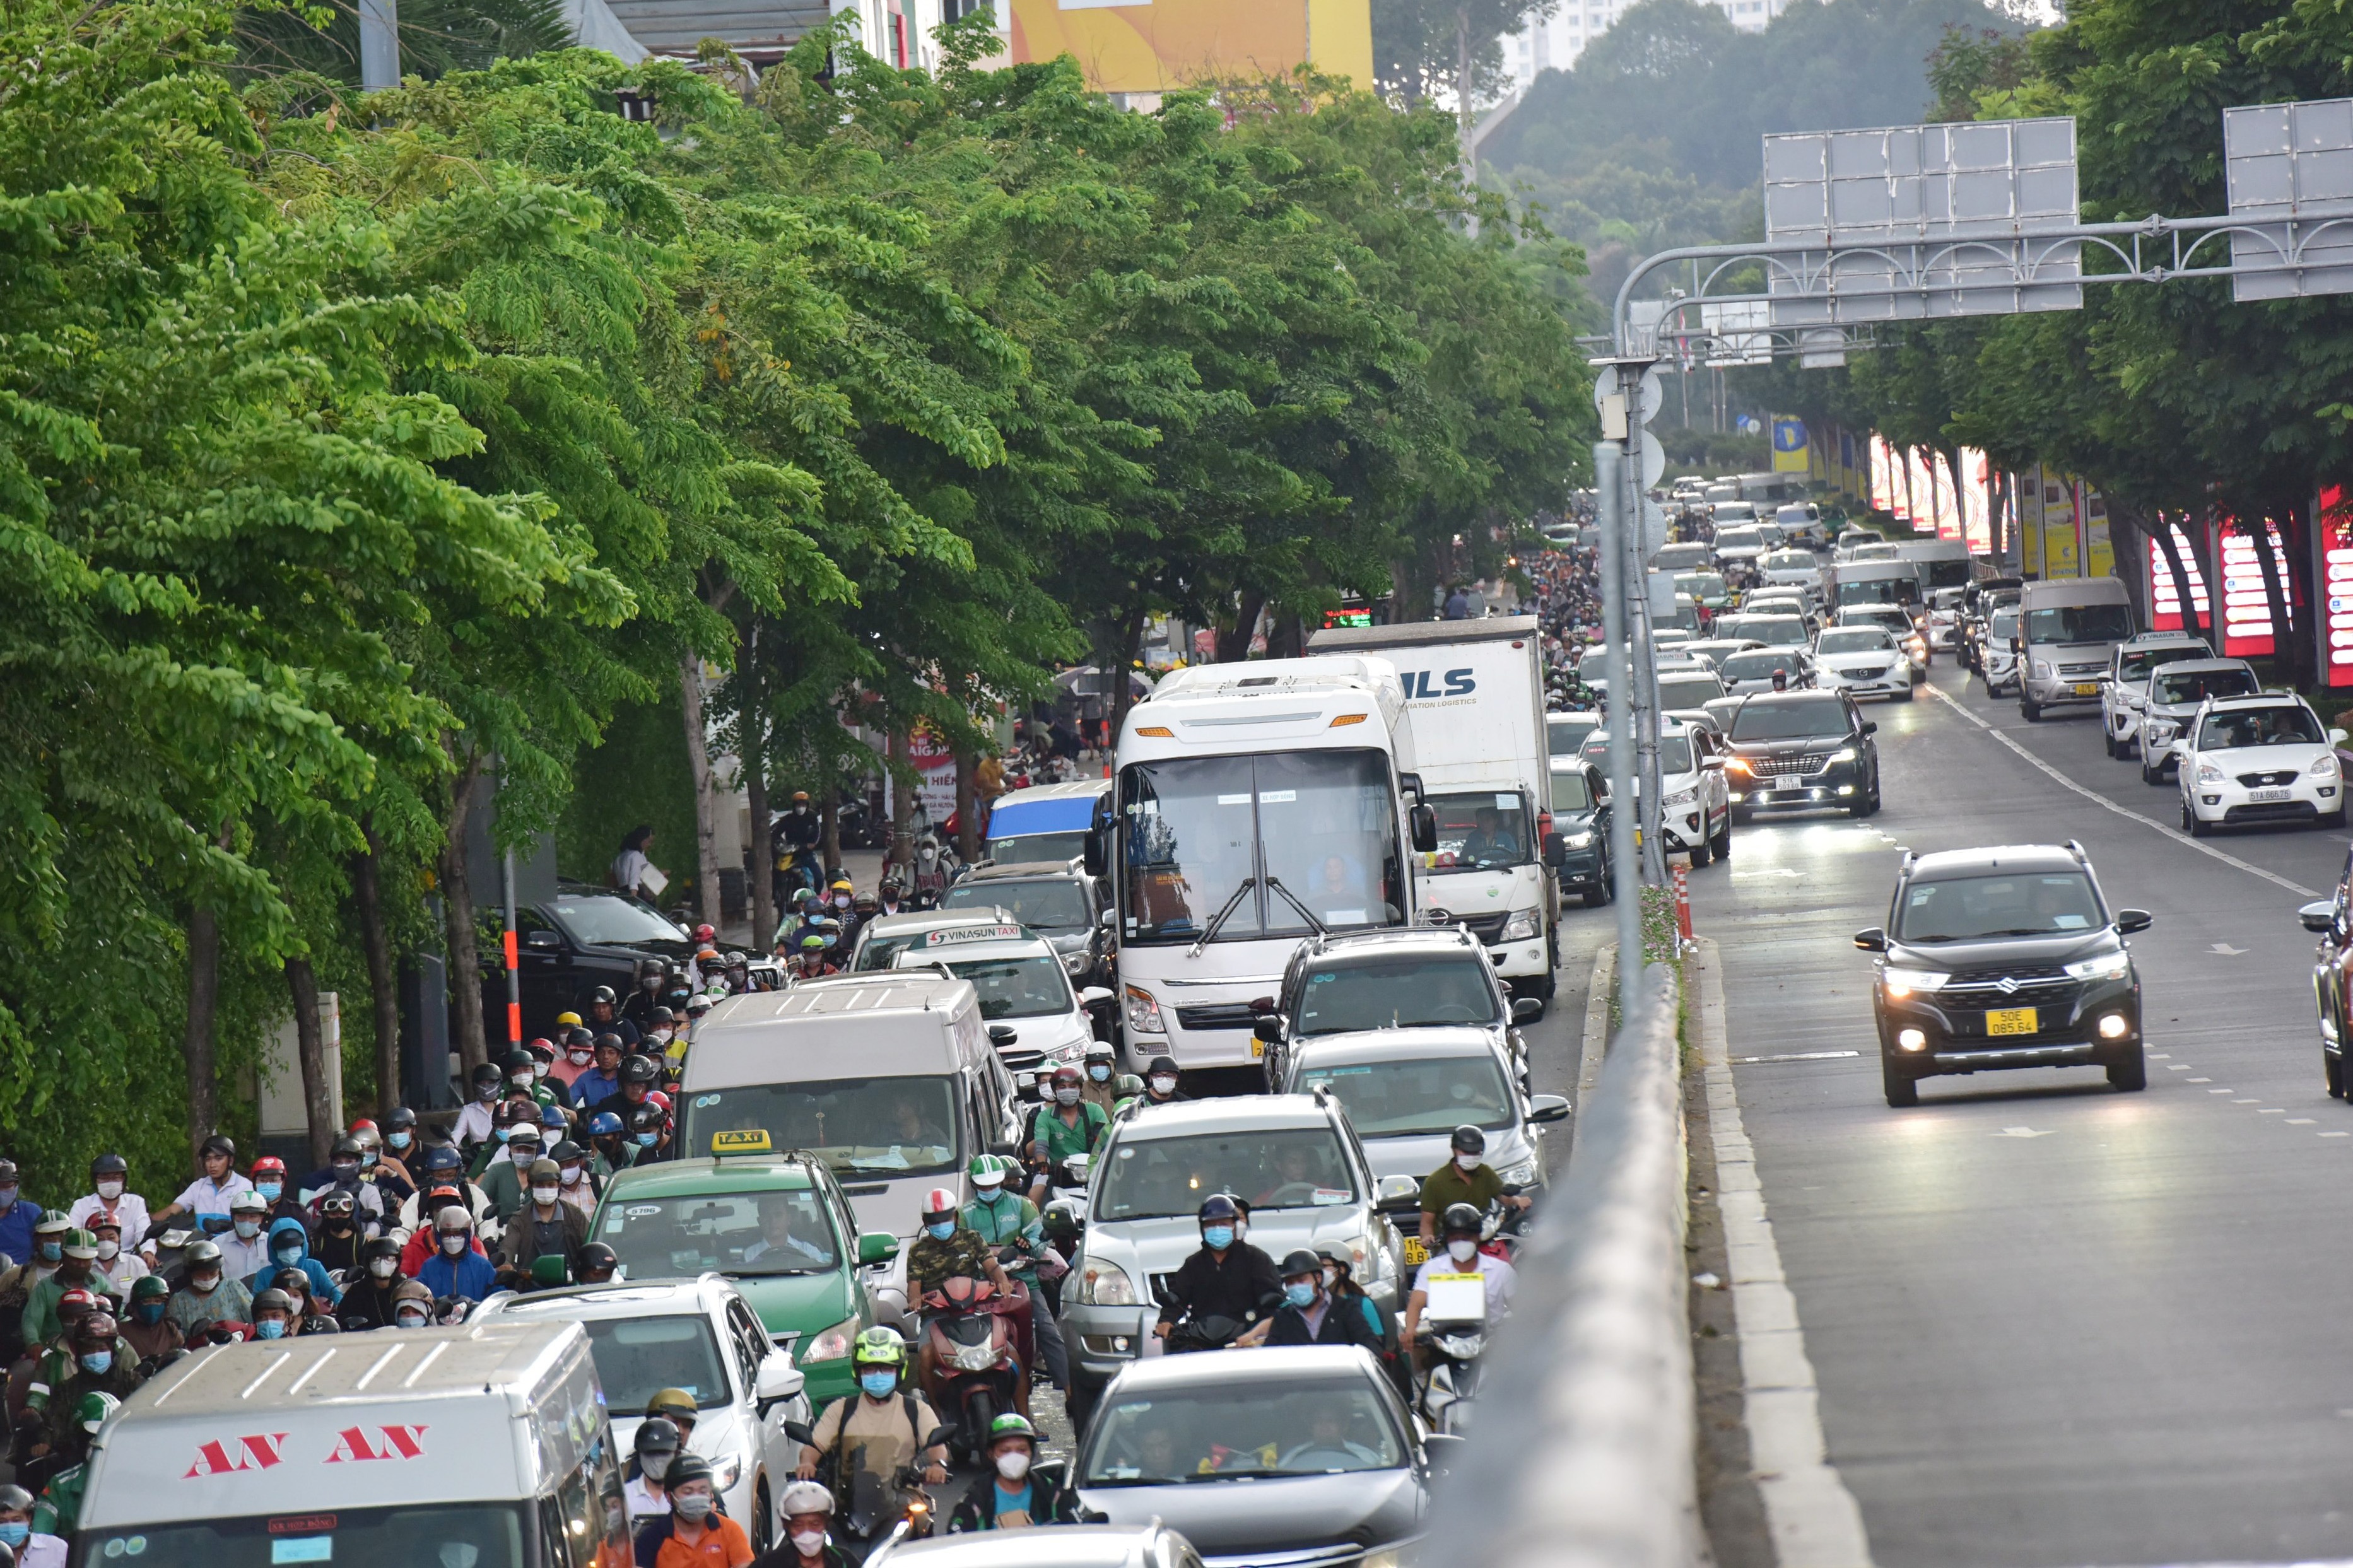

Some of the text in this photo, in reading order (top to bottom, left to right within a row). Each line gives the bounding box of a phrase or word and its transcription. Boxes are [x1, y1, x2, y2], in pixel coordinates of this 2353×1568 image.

[1437, 698, 1477, 708] LOGISTICS
[948, 927, 1018, 940] VINASUN TAXI
[2000, 1010, 2022, 1021] 50E
[1993, 1022, 2033, 1034] 085.64
[720, 1132, 760, 1143] TAXI
[999, 1214, 1018, 1222] Grab
[180, 1425, 431, 1480] AN AN
